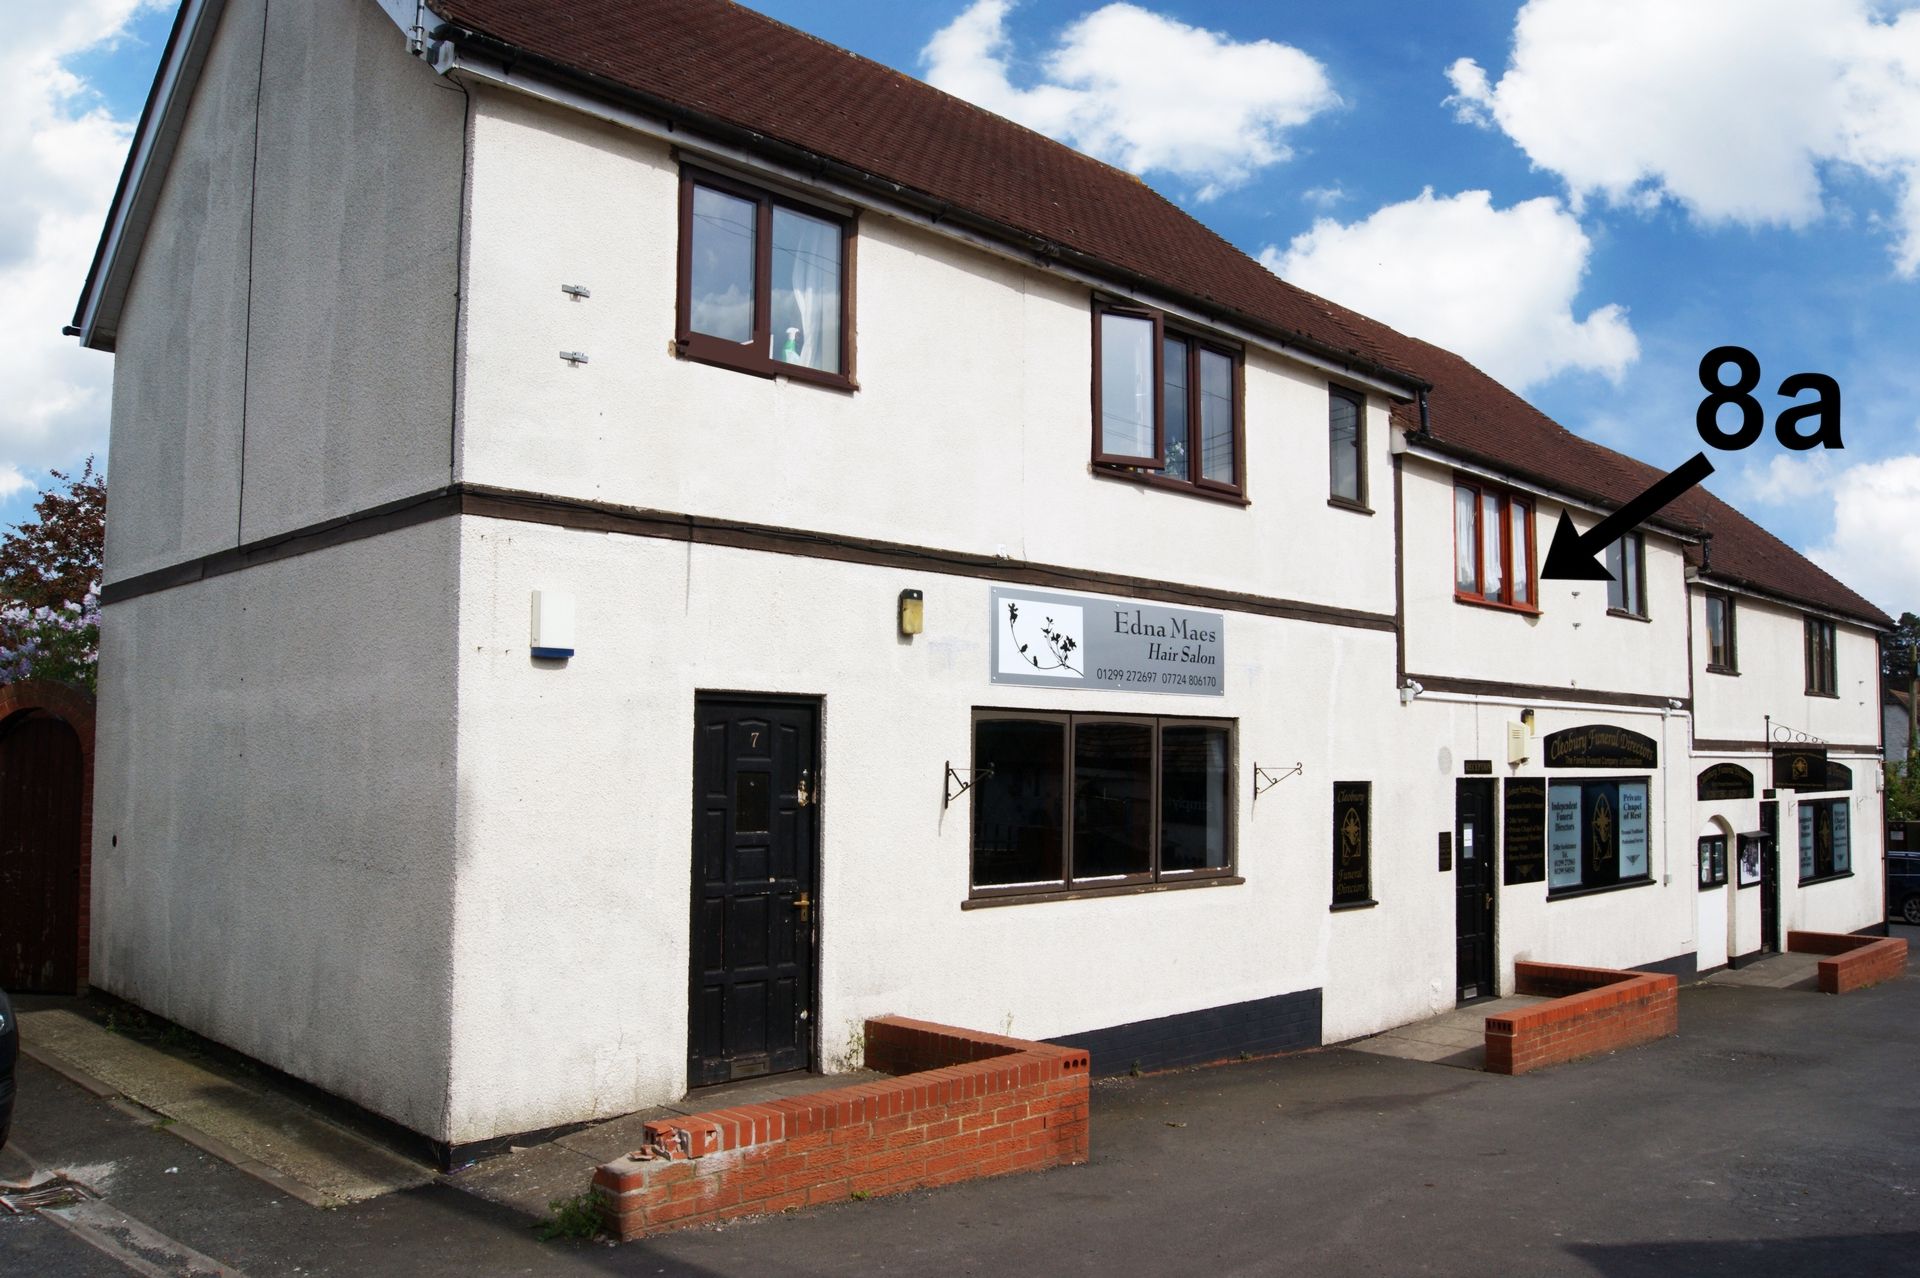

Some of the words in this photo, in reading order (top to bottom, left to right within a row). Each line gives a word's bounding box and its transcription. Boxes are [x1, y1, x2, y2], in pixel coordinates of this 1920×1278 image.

[1114, 610, 1166, 638] Edna
[1170, 617, 1216, 643] Maes
[1148, 643, 1178, 662] Hair
[1181, 645, 1216, 665] Salon
[1096, 668, 1124, 681] 01299
[1126, 670, 1157, 683] 272697
[1161, 672, 1187, 685] 07724
[1188, 674, 1217, 687] 806170
[750, 732, 760, 748] 7
[1588, 728, 1620, 750] Funeral
[1623, 802, 1642, 813] Chapel
